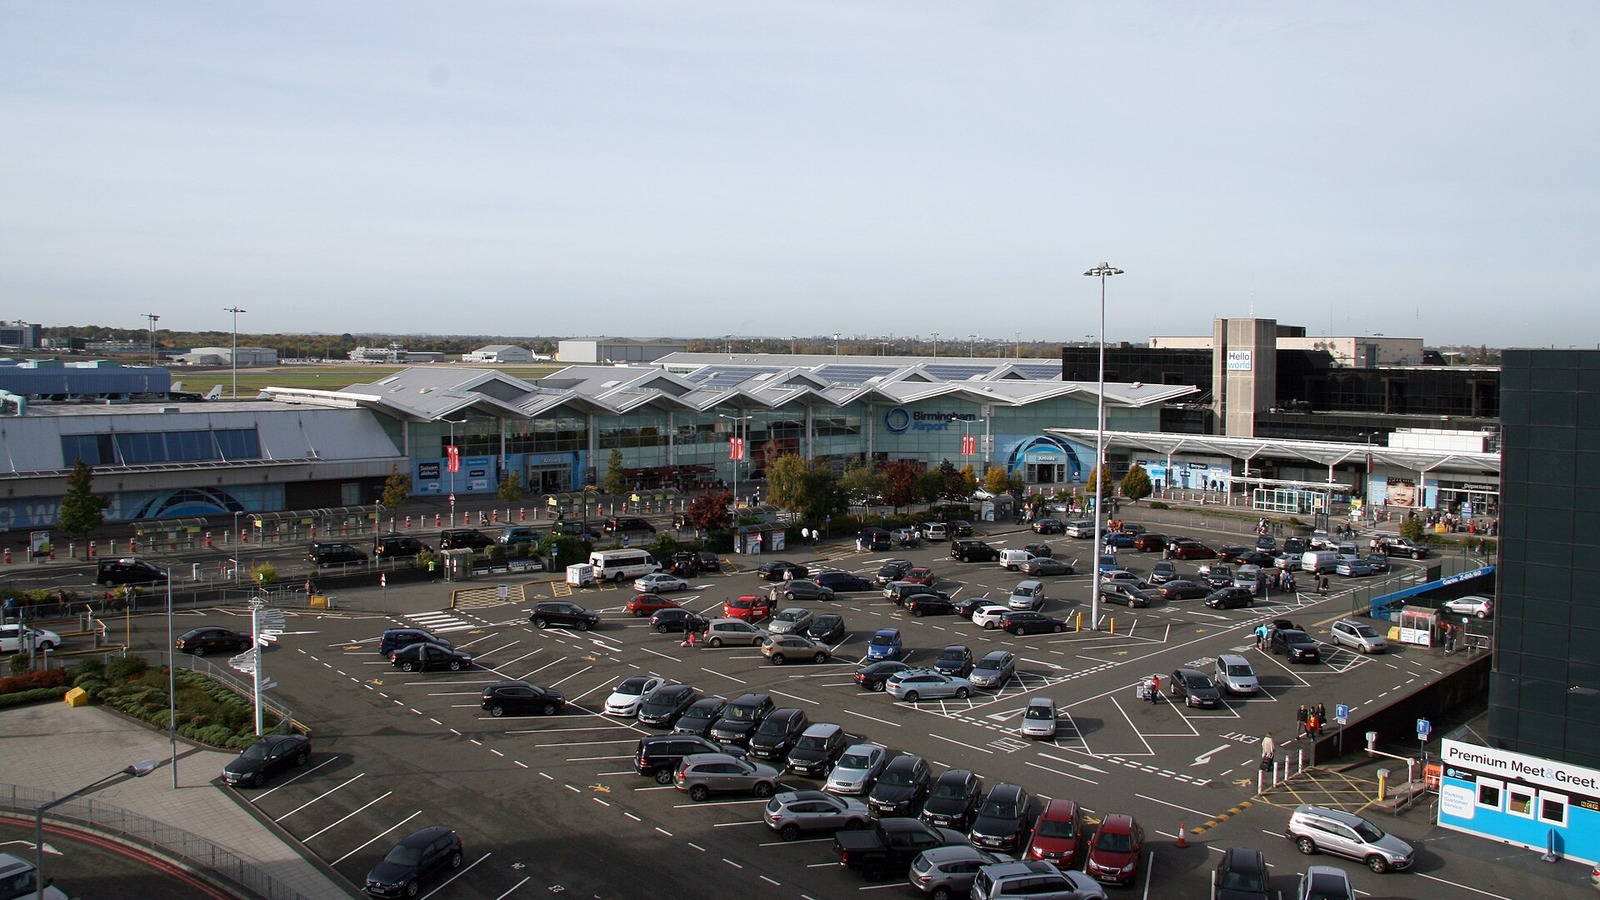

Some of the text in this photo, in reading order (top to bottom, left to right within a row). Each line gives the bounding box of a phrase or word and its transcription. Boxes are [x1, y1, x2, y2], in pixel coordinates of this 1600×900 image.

[1228, 352, 1250, 360] Hello
[1228, 361, 1250, 369] world
[913, 411, 976, 423] Birmingham
[912, 422, 948, 432] Airport
[1219, 731, 1261, 744] EXIT
[1449, 747, 1508, 769] Premium
